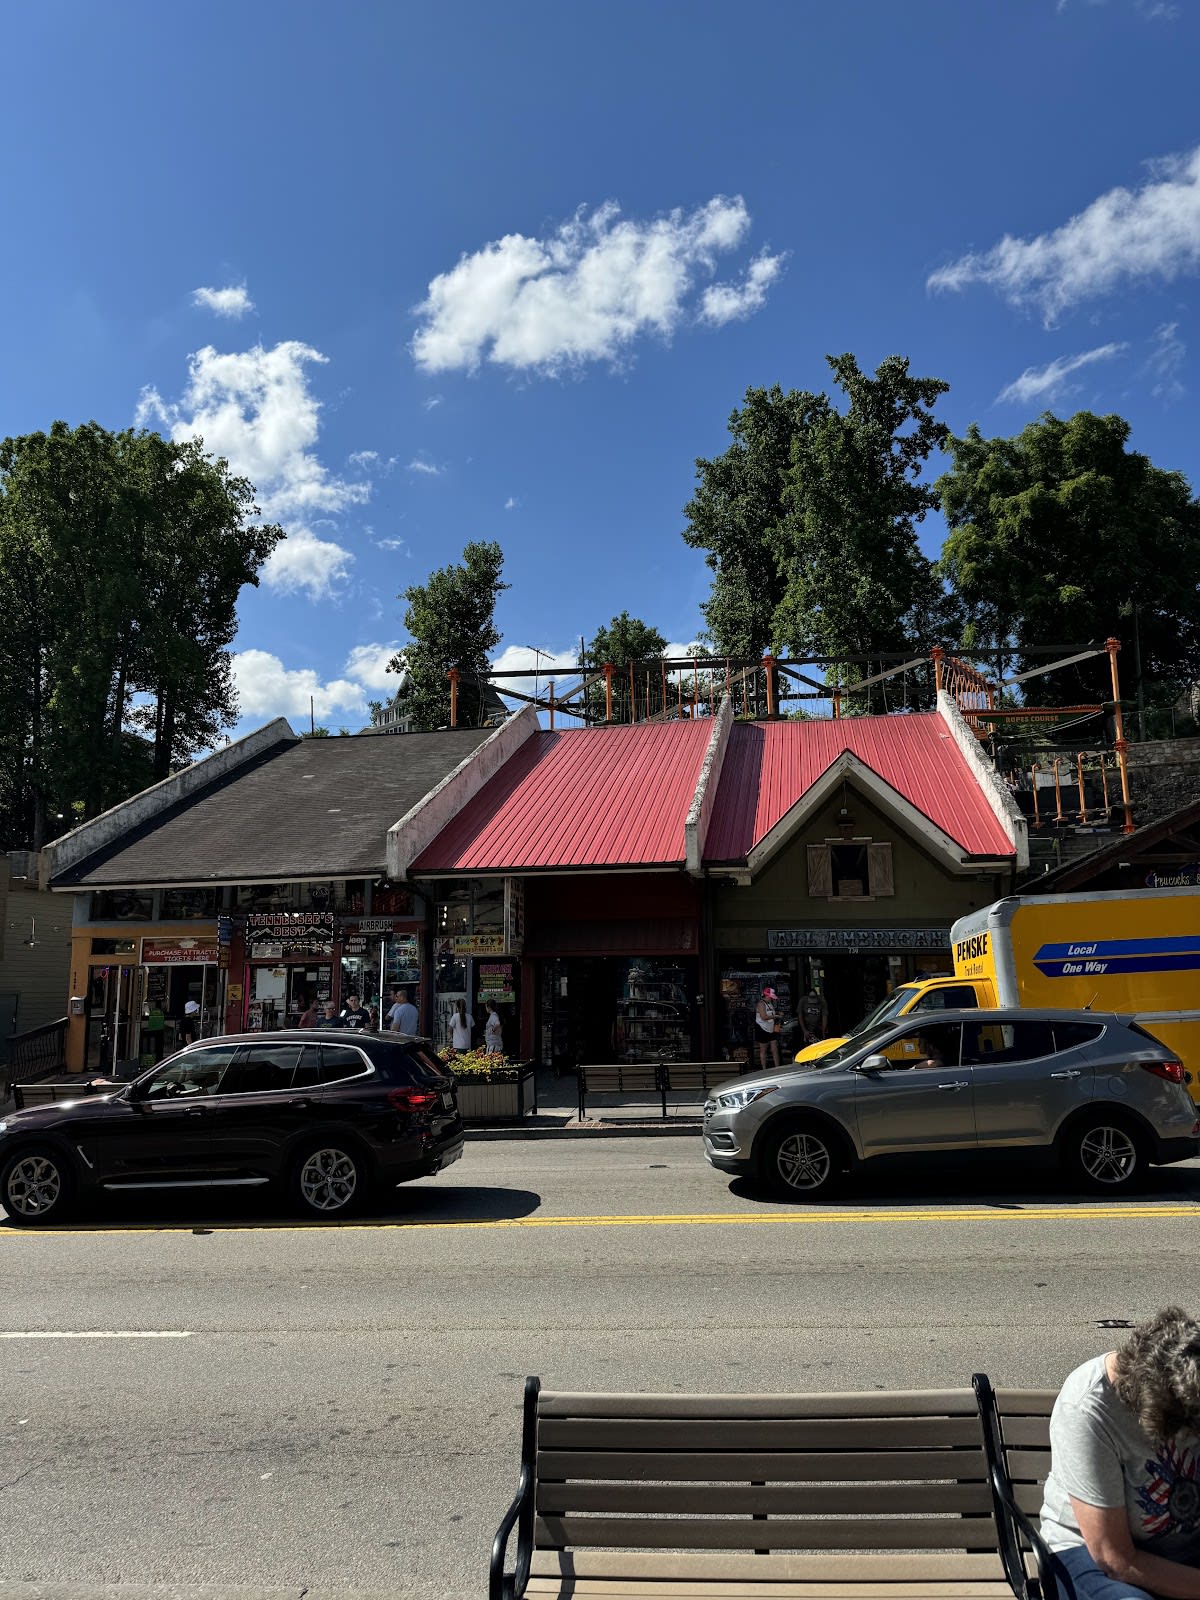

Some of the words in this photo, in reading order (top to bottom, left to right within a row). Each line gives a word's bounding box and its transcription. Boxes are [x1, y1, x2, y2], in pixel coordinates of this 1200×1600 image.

[249, 914, 333, 926] TENNESSEE'S
[358, 920, 393, 932] AIRBRUSH
[273, 926, 306, 937] BEST
[349, 936, 367, 944] Jeep
[775, 932, 817, 947] ALL
[826, 931, 944, 948] AMERICAN
[957, 933, 988, 962] PENSKE
[1067, 944, 1097, 956] Local
[1062, 962, 1082, 974] One
[1084, 961, 1108, 974] Way
